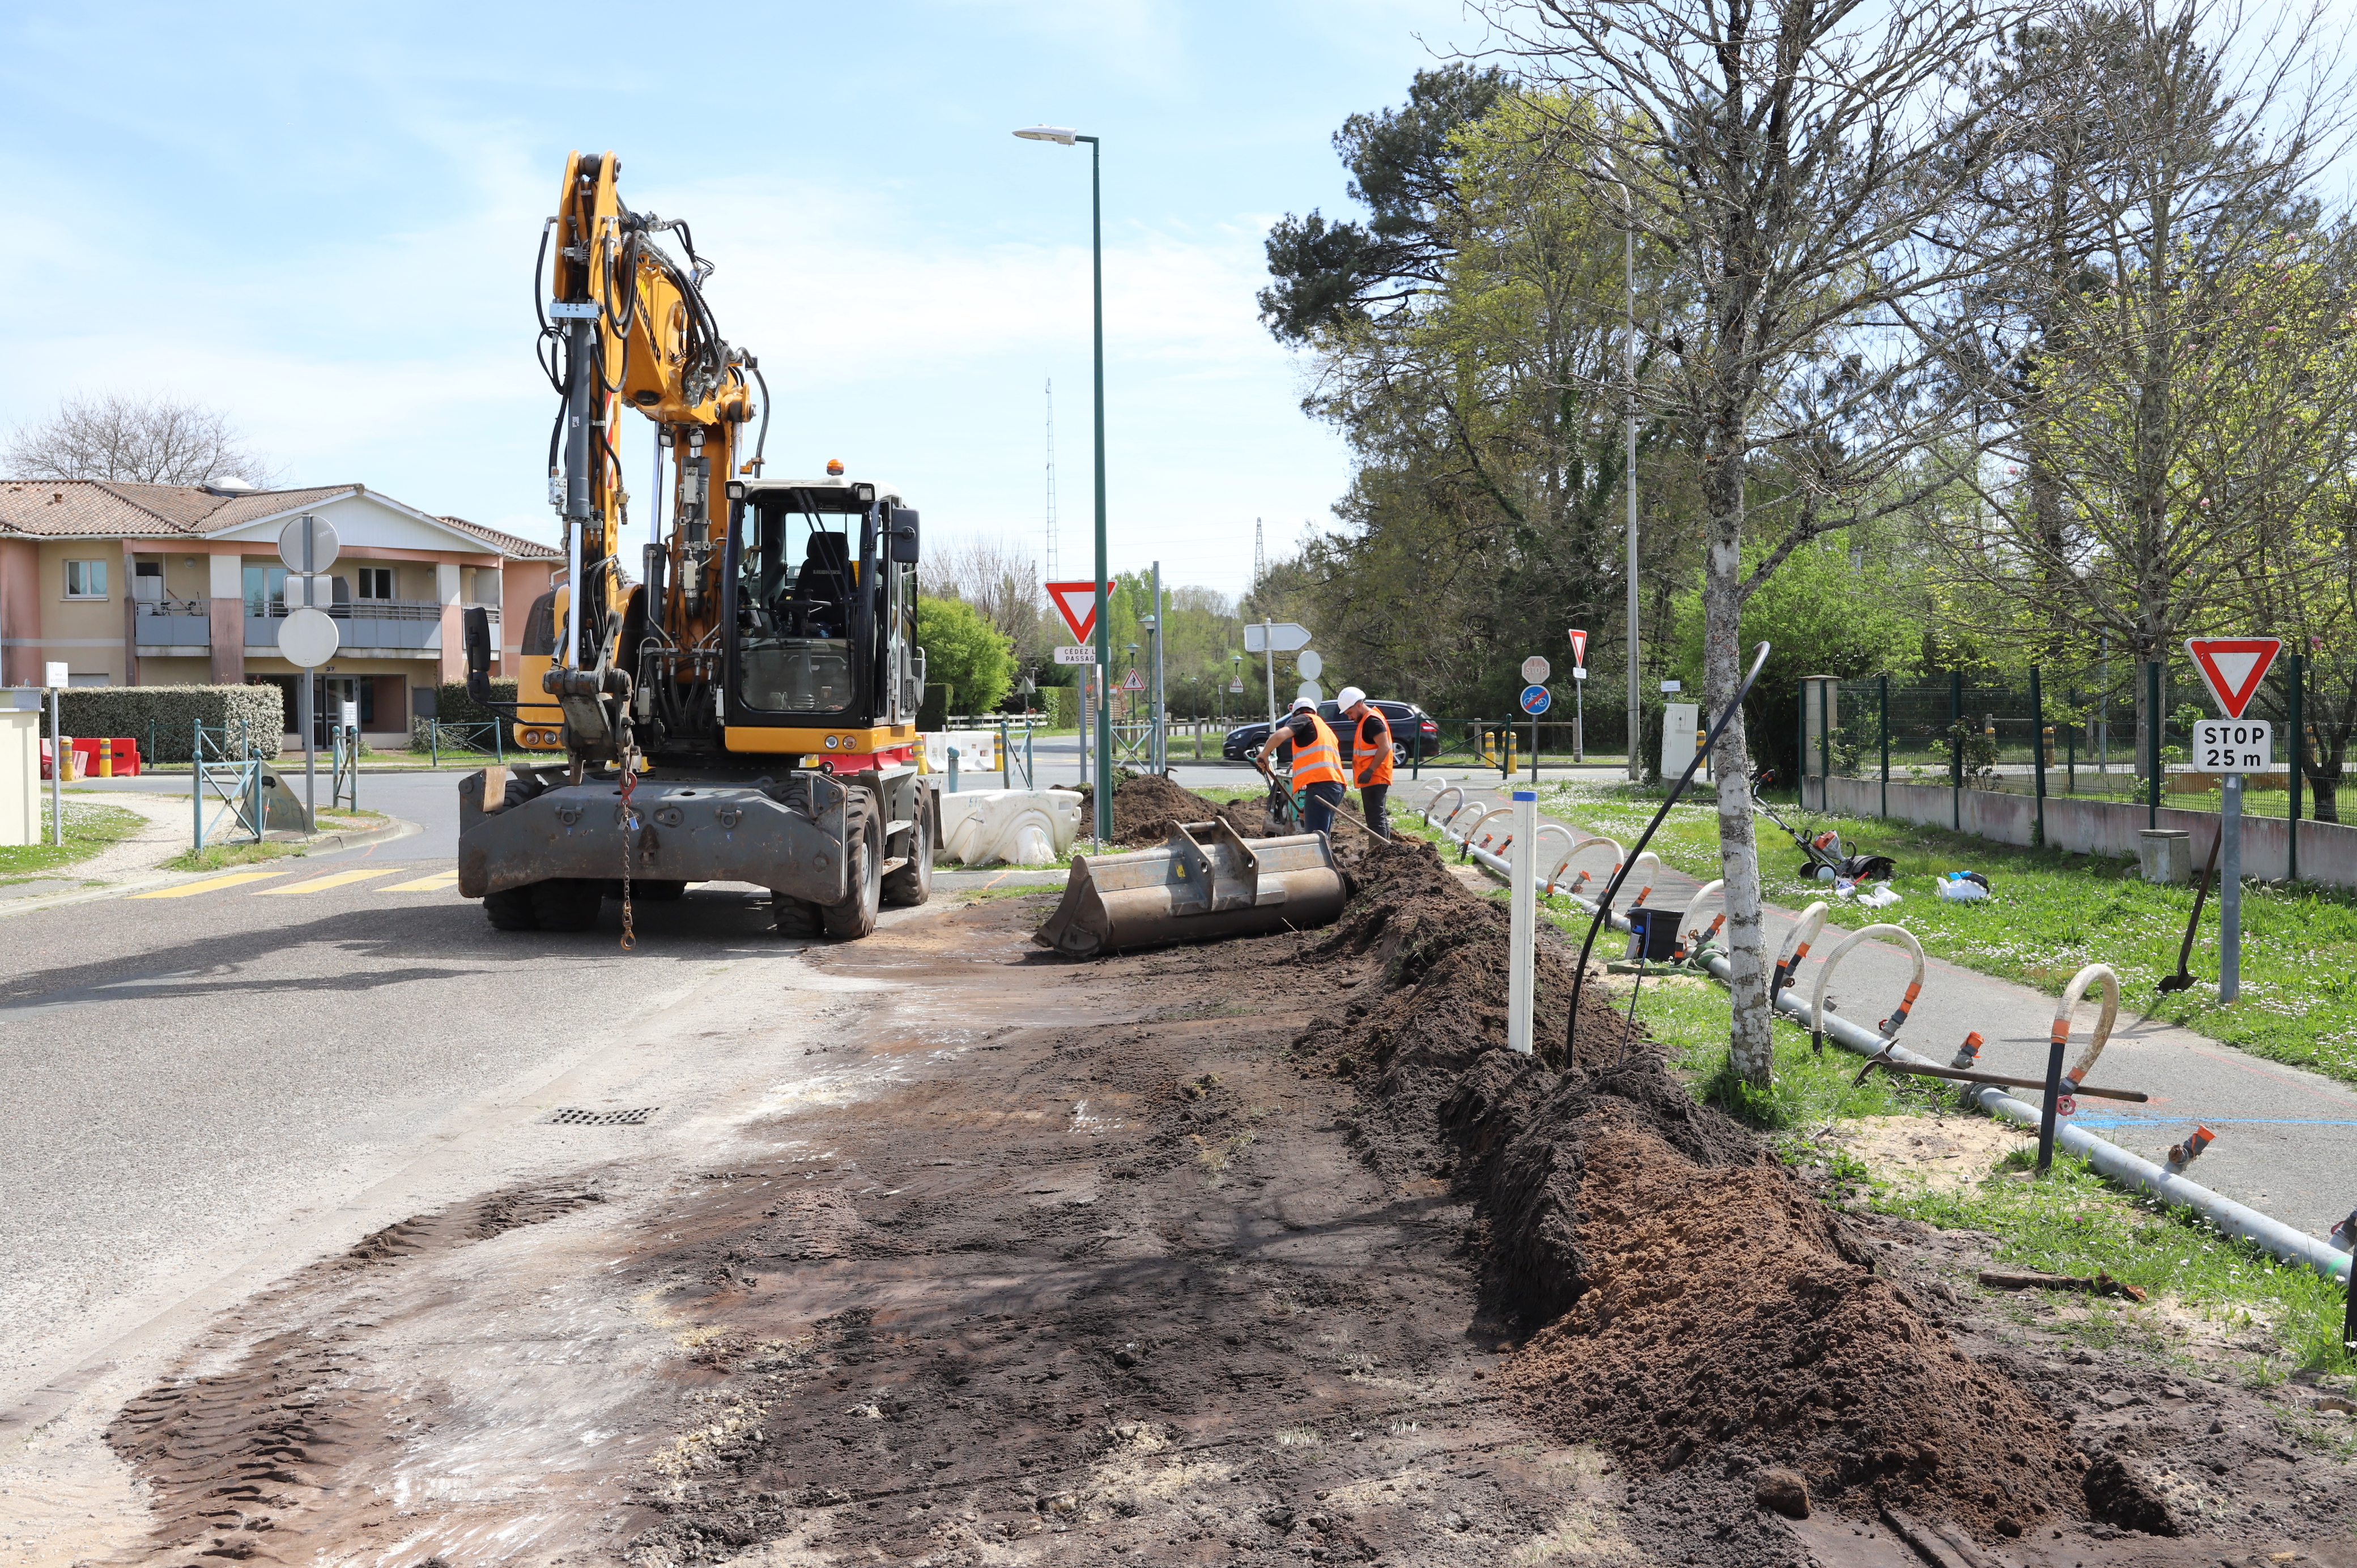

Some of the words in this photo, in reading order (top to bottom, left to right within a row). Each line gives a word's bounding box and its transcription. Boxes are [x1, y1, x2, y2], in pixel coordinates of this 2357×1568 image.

[2203, 727, 2265, 744] STOP
[2207, 749, 2235, 766] 25
[2243, 754, 2261, 766] m
